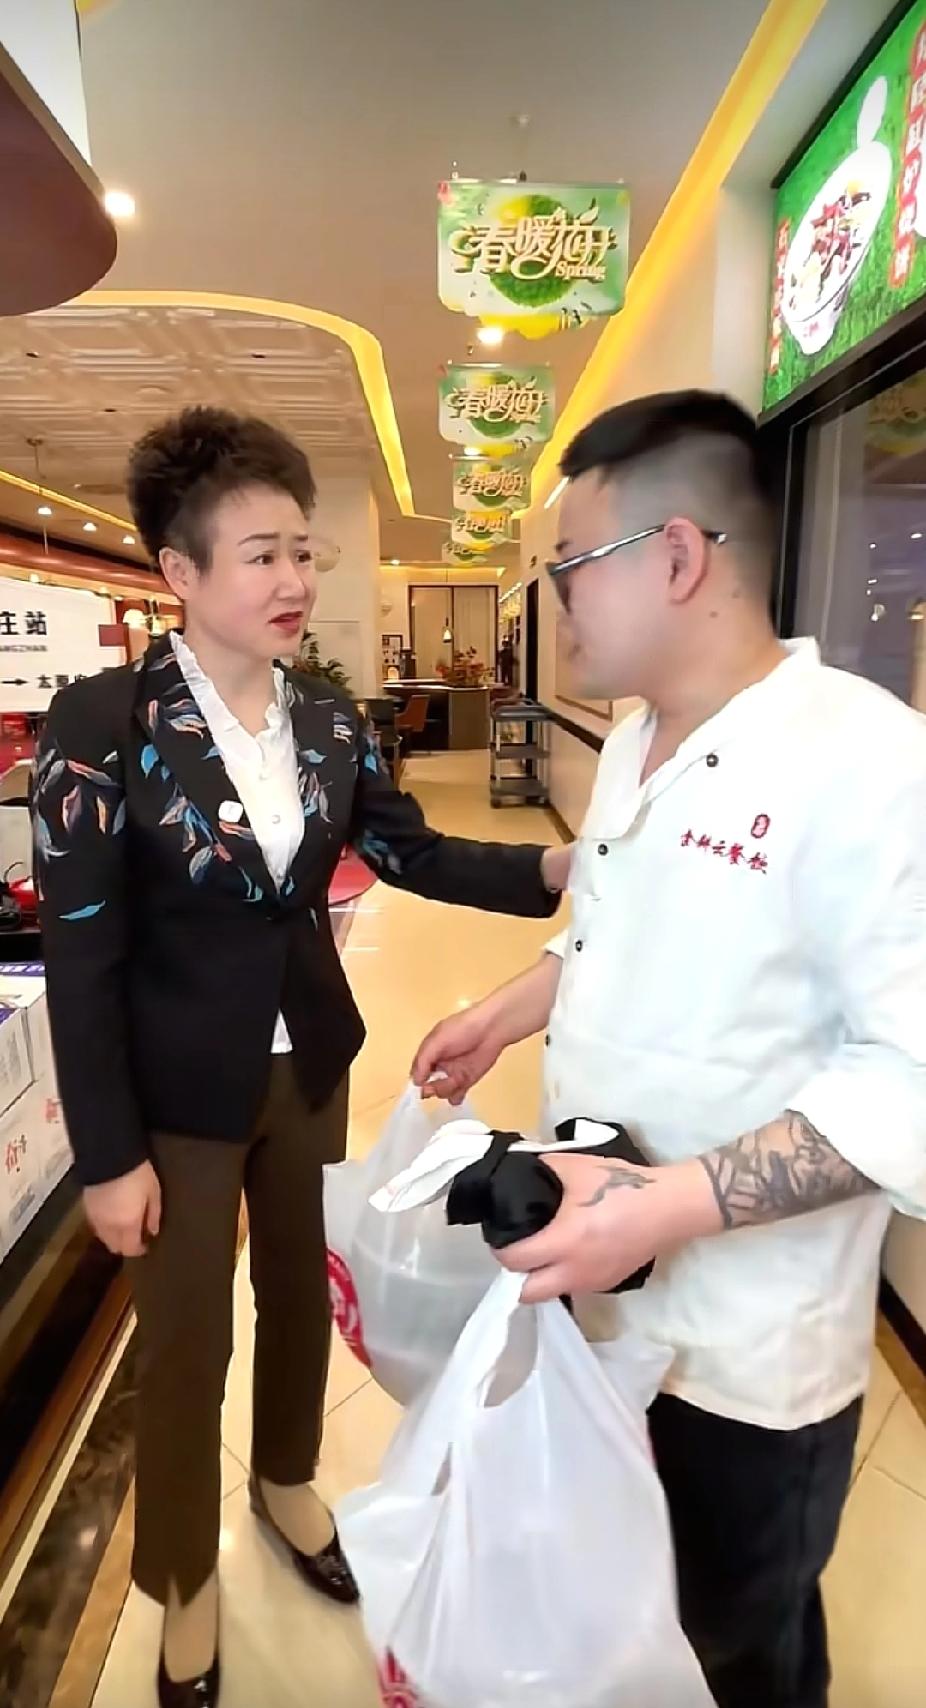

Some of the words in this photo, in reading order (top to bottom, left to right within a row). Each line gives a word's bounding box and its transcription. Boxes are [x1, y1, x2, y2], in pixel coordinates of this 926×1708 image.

[450, 207, 617, 280] 春暖花开
[554, 261, 607, 284] Spring
